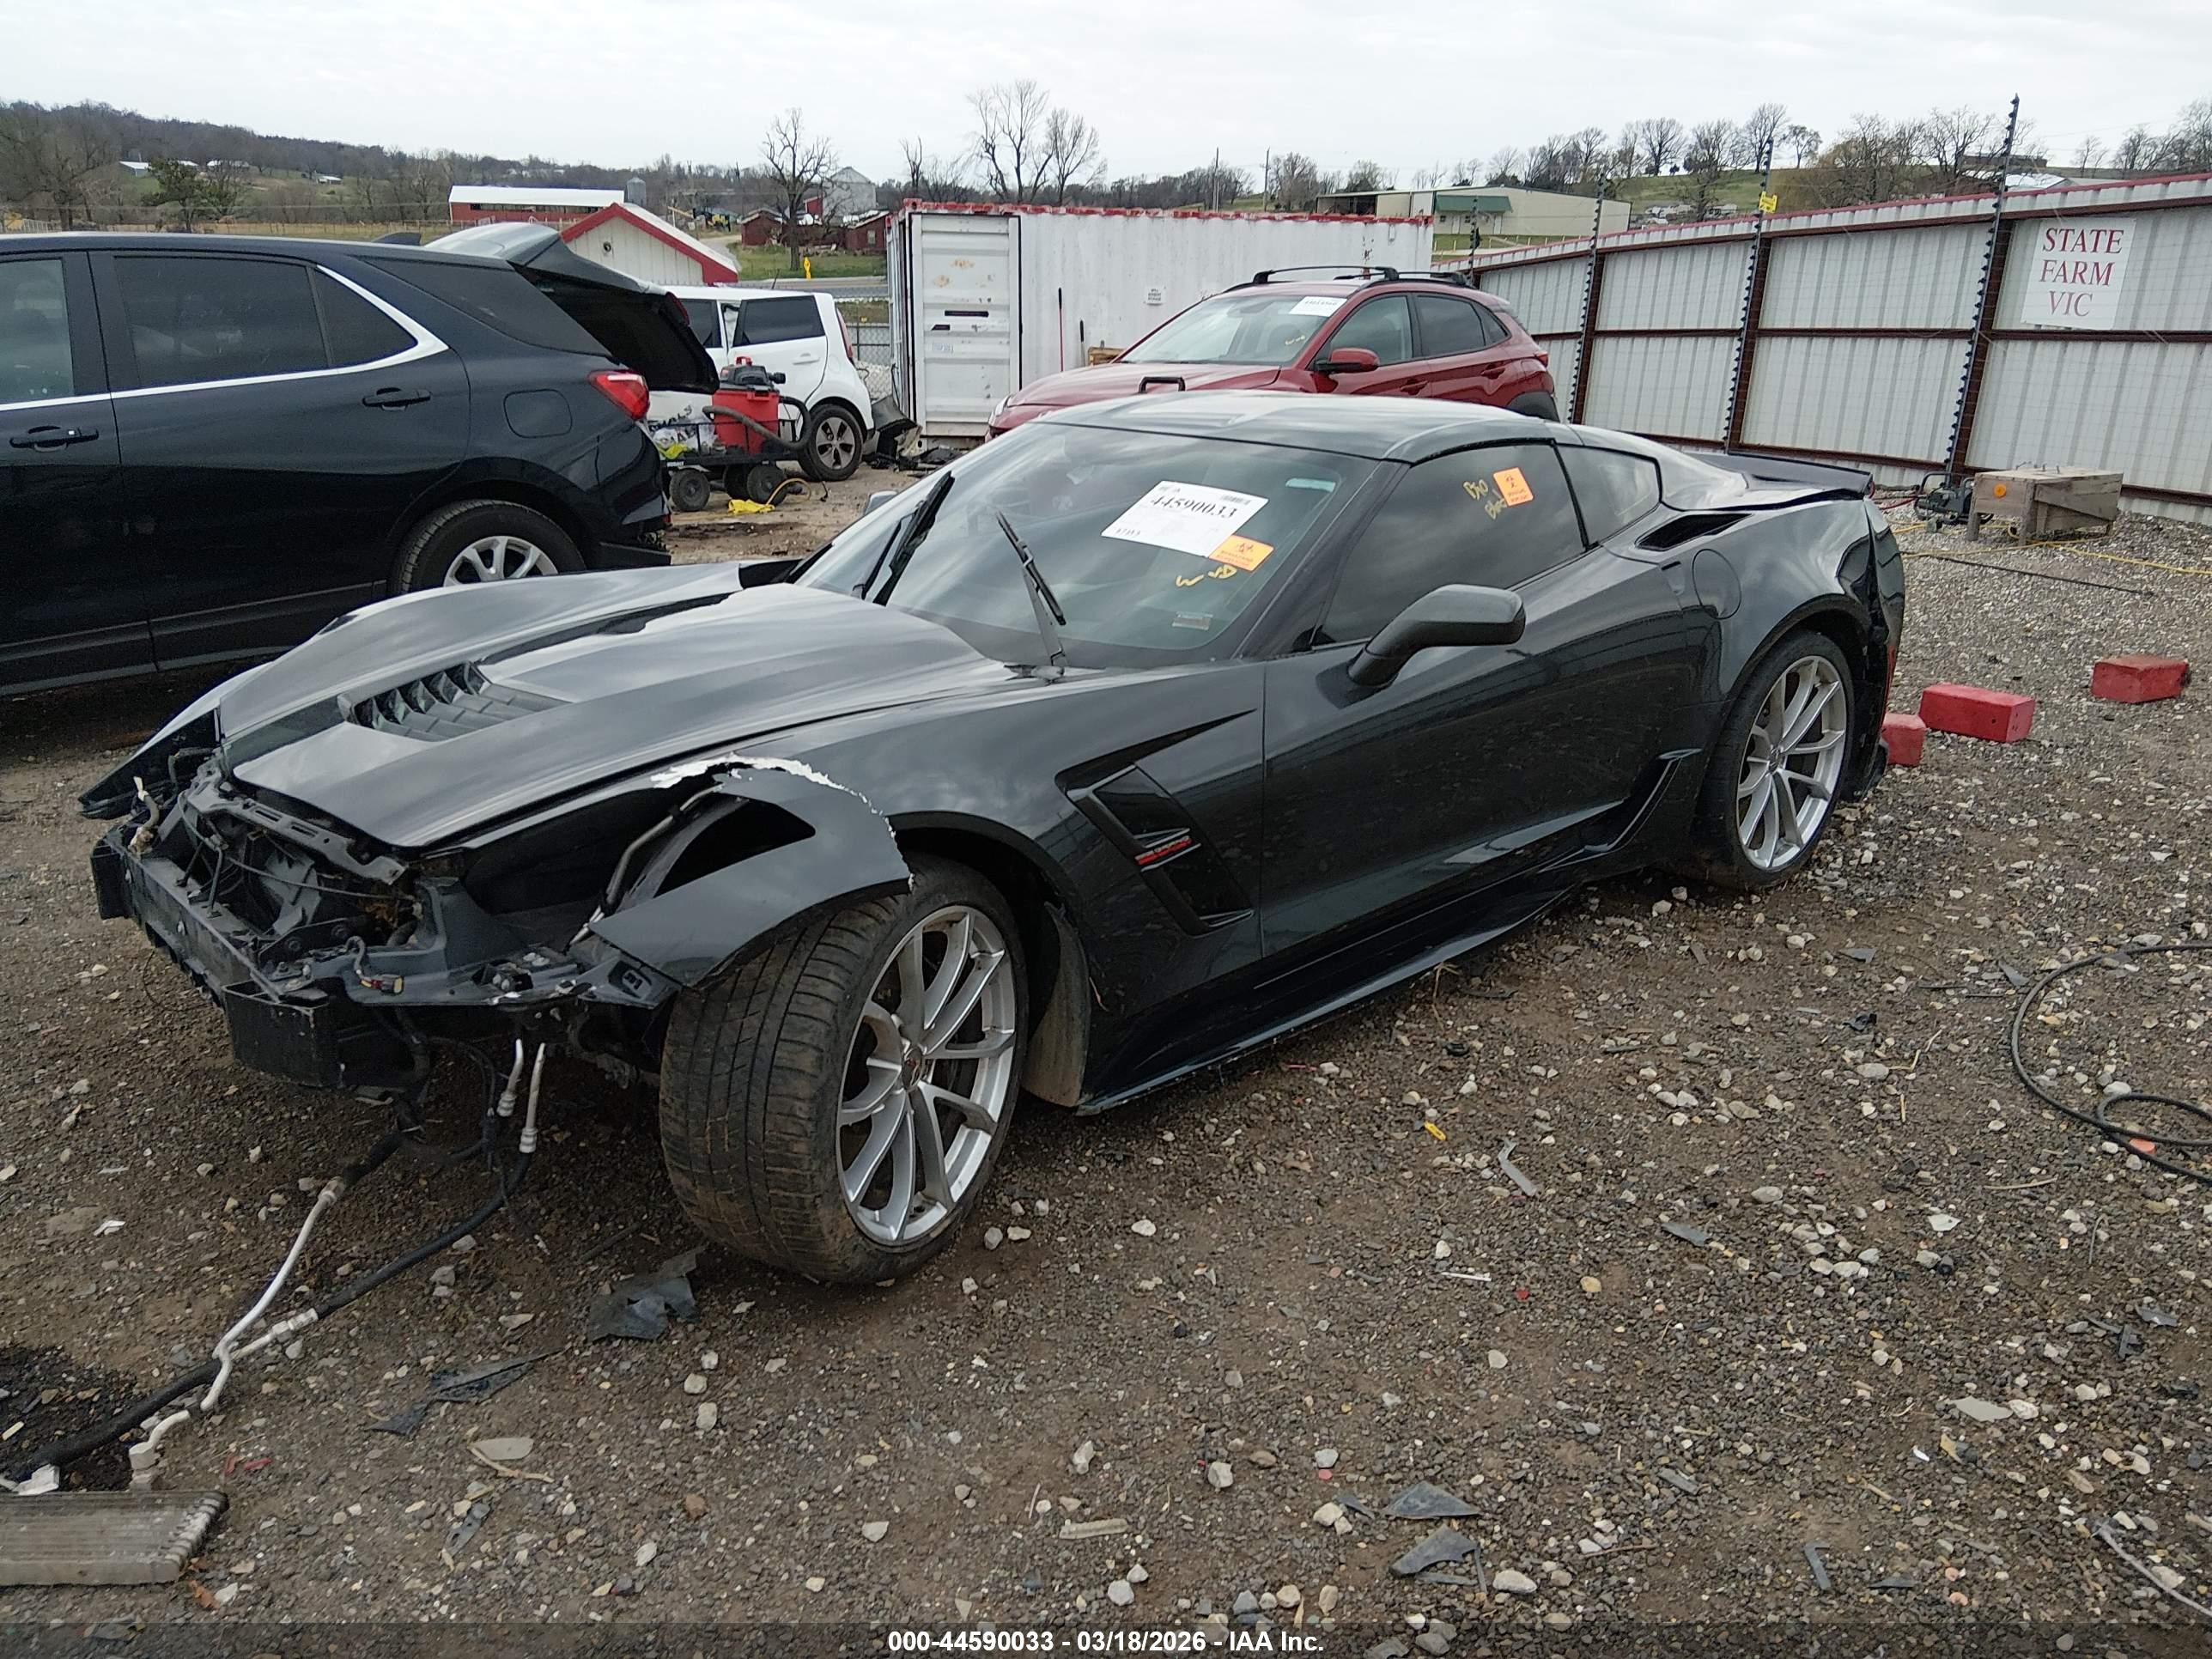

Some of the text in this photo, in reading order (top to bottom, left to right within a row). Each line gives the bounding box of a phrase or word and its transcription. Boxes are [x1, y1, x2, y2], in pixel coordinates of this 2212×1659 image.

[2042, 228, 2124, 254] STATE
[2039, 259, 2115, 286] FARM
[2049, 290, 2093, 317] VIC
[1151, 495, 1237, 519] 44590033
